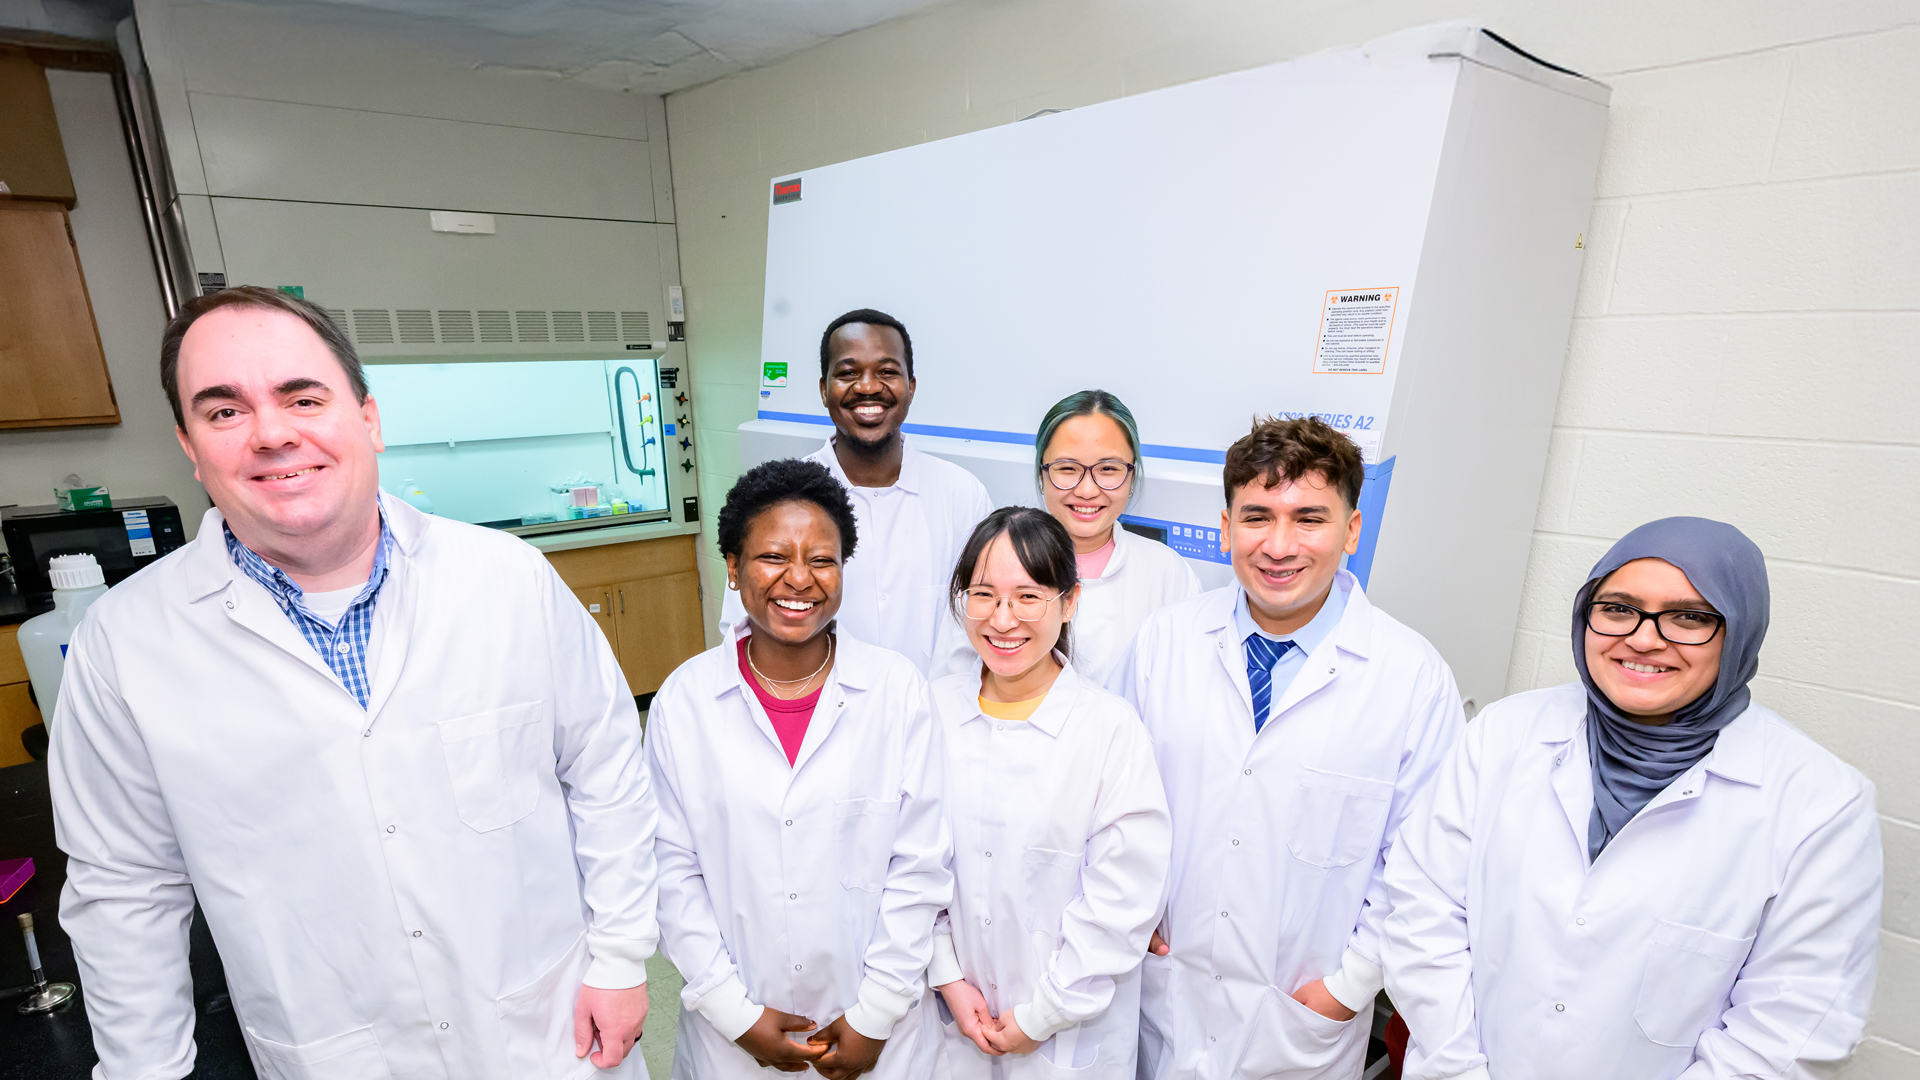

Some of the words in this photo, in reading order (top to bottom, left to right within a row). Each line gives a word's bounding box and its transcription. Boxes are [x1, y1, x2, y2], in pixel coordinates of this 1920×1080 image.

[775, 184, 800, 195] Thermo
[1340, 294, 1381, 303] WARNING
[1307, 412, 1353, 429] RIES
[1353, 415, 1375, 430] A2
